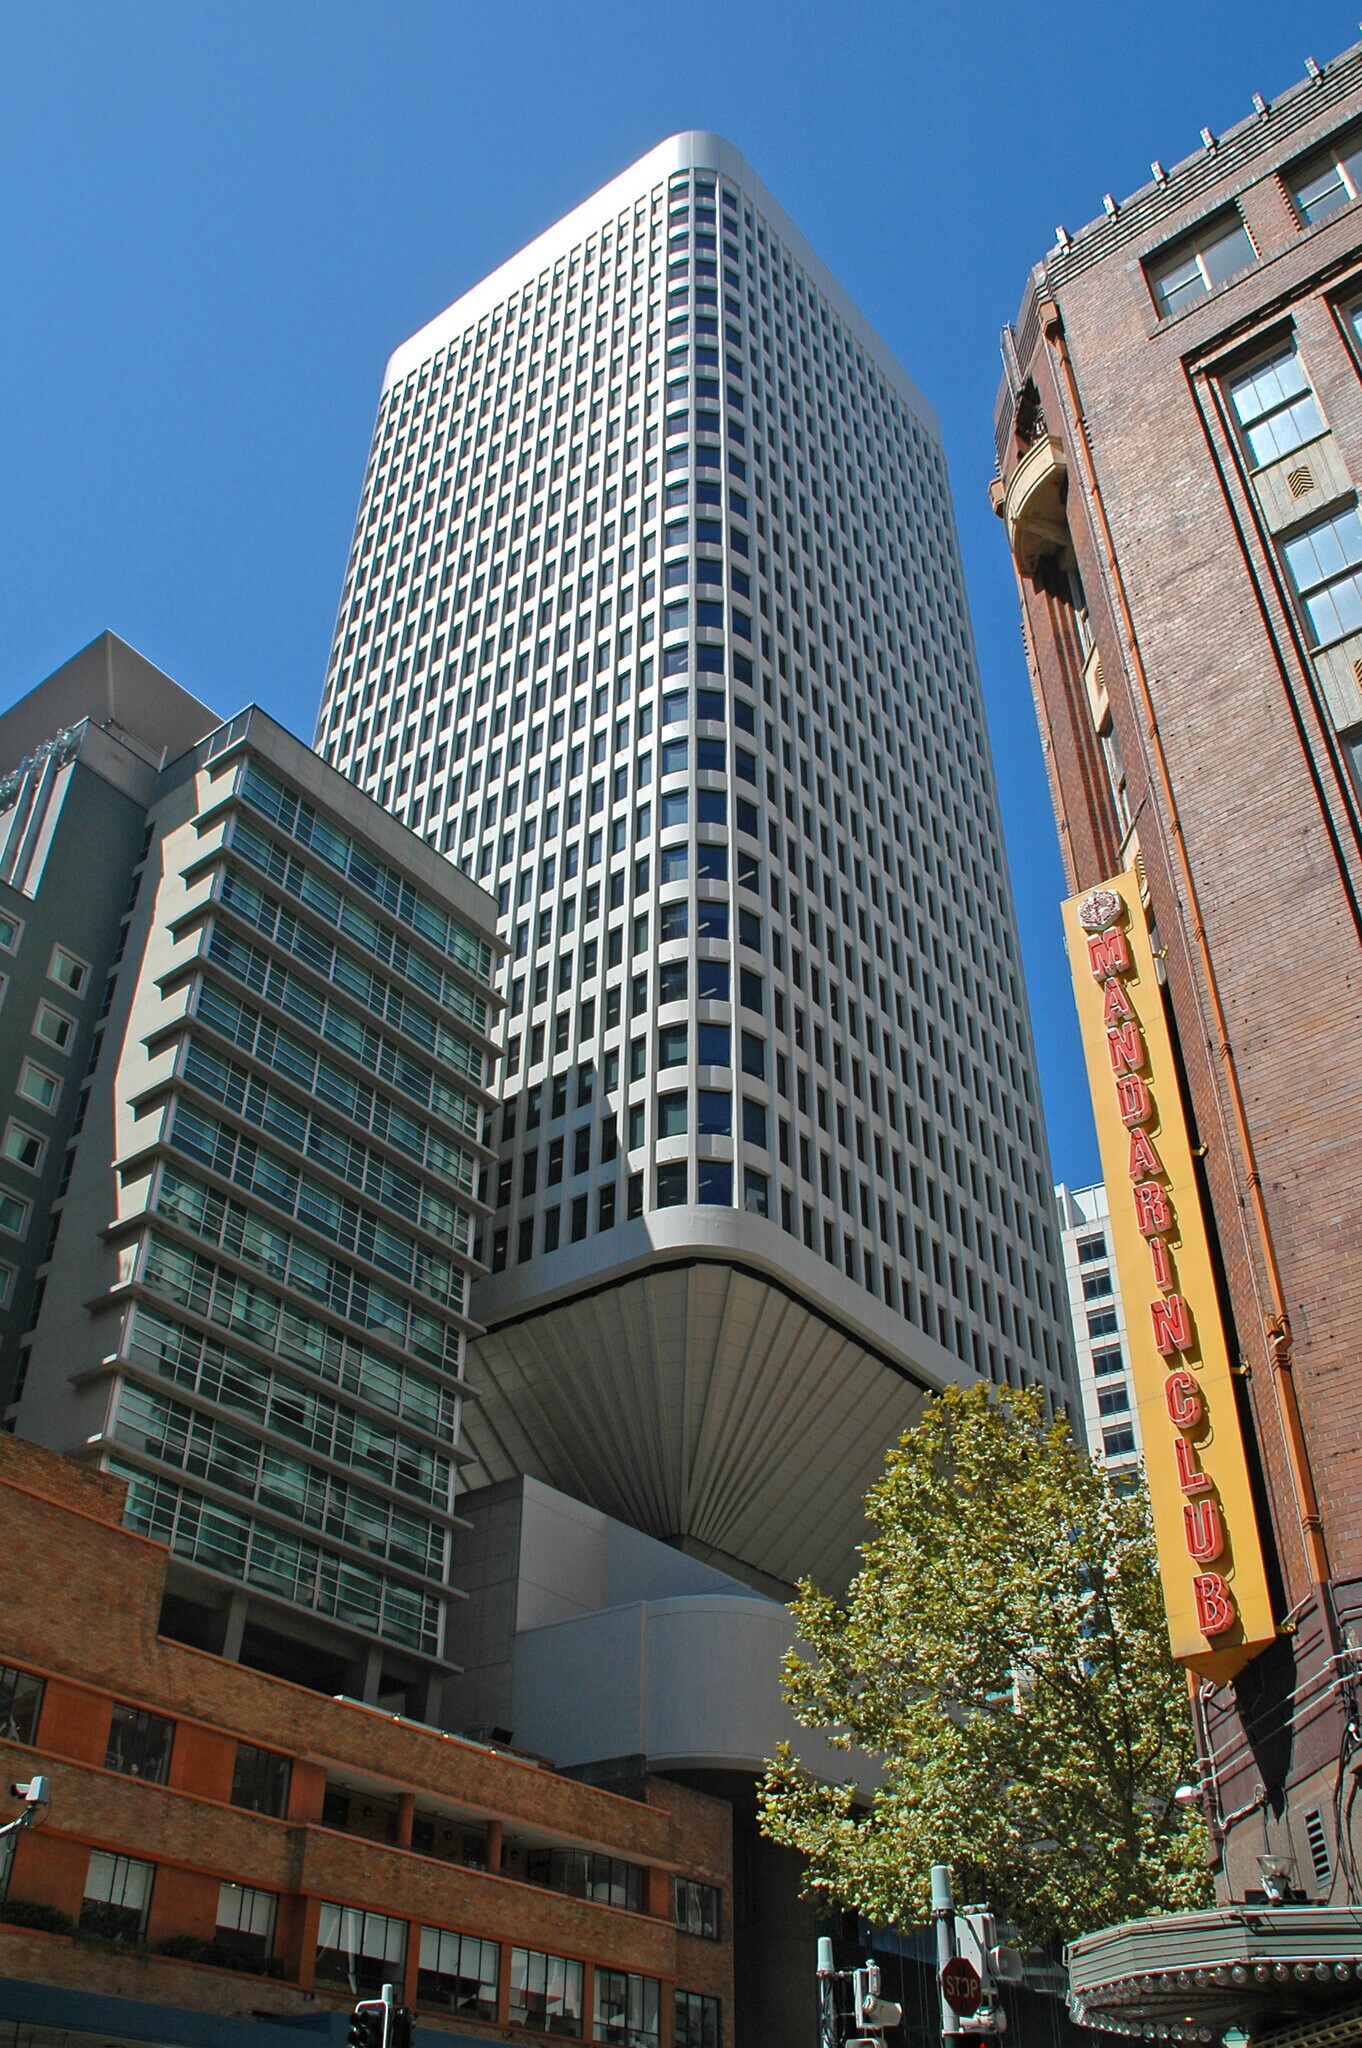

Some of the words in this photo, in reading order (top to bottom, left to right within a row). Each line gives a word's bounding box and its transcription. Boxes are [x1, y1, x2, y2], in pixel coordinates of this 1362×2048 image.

[1086, 926, 1193, 1355] MANDARIN
[1164, 1370, 1236, 1637] CLUB
[946, 1975, 978, 1999] STOP
